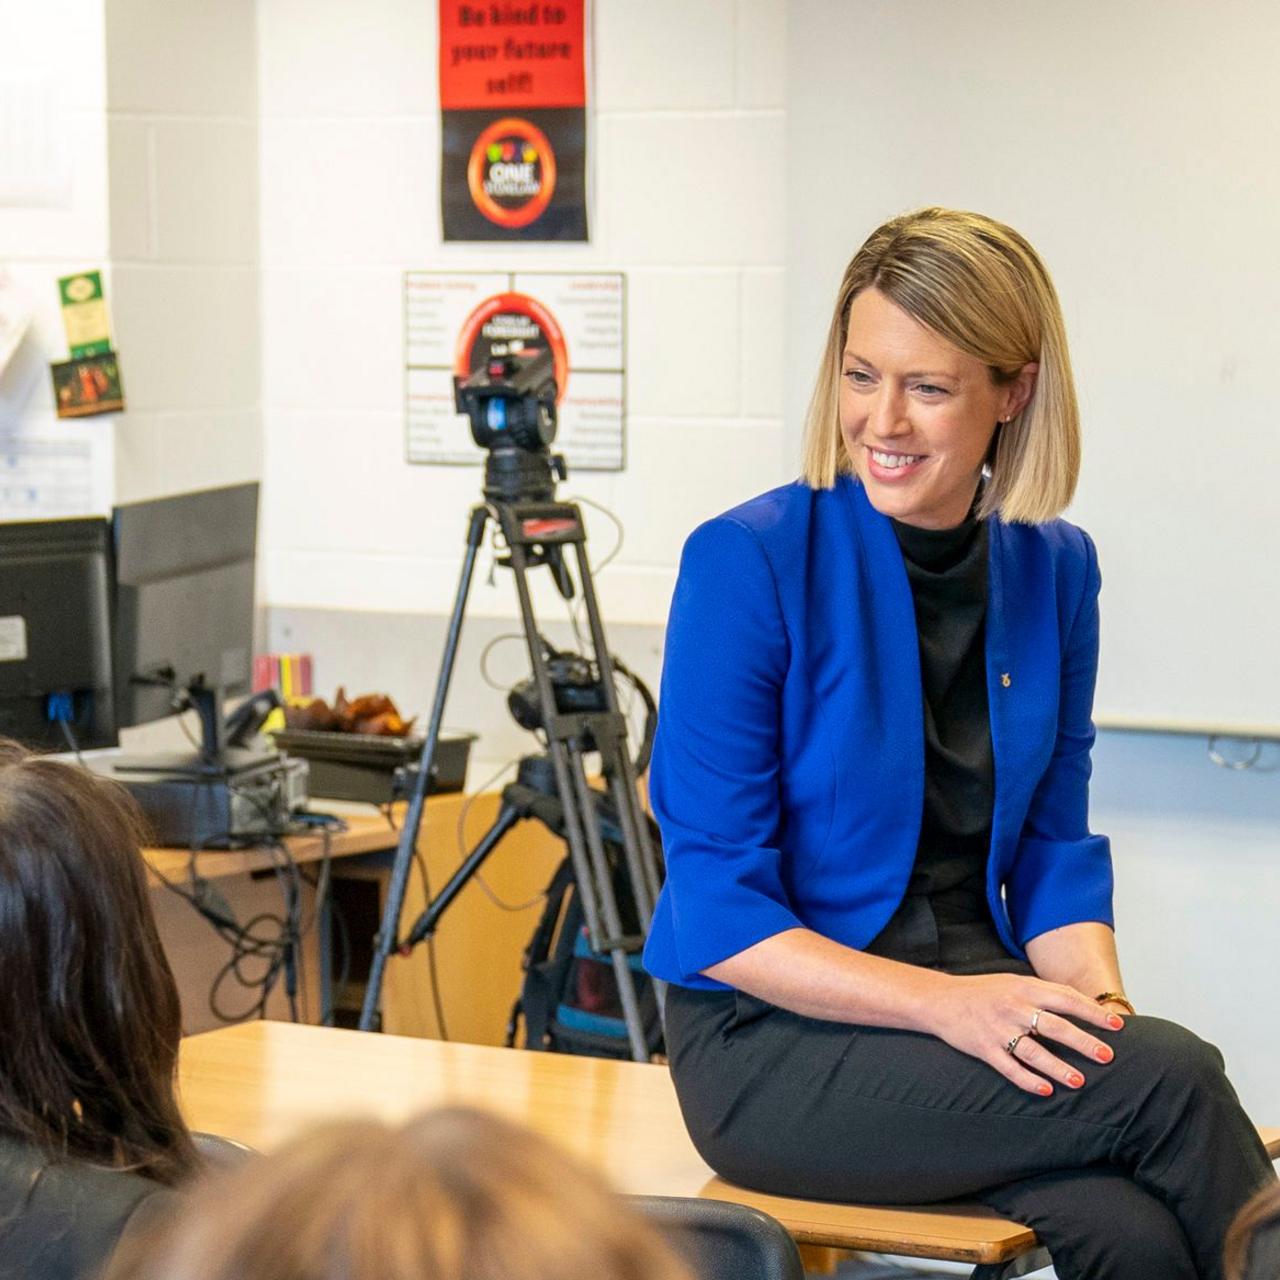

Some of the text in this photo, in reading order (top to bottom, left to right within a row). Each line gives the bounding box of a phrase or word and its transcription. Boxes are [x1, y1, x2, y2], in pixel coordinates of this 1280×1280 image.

[459, 3, 566, 27] Be kind to
[450, 38, 571, 66] your future
[489, 163, 535, 181] ONE
